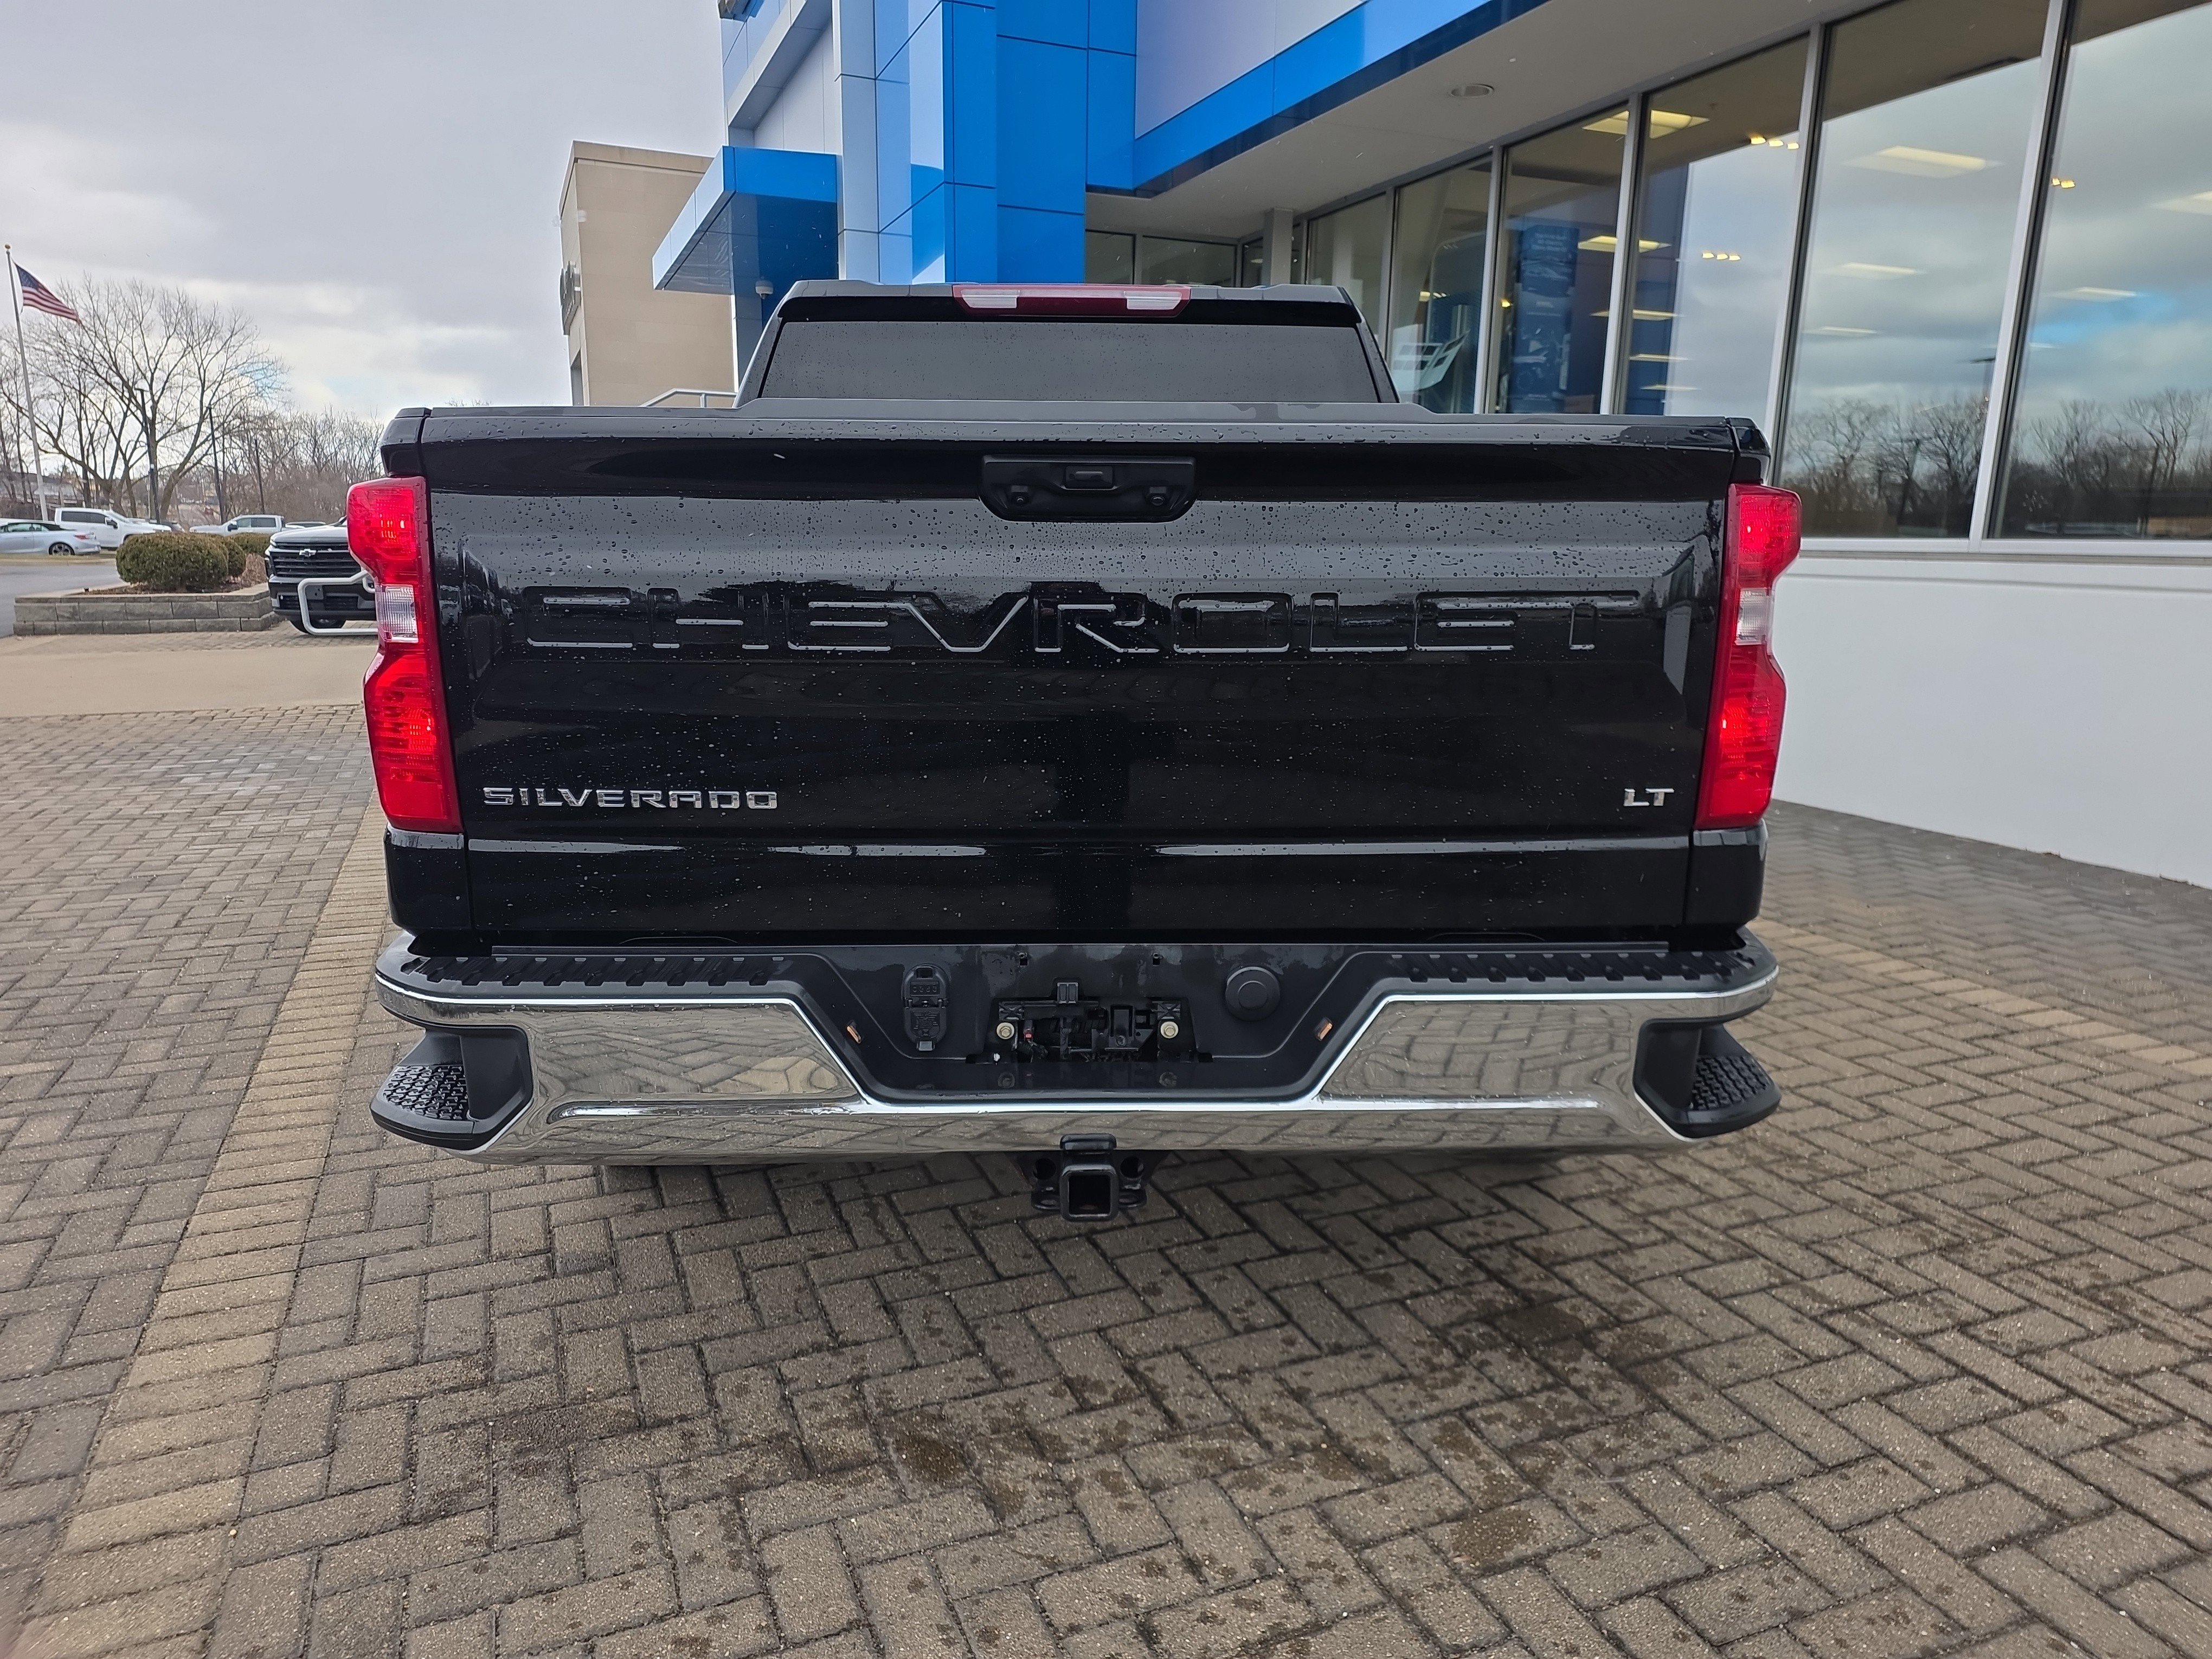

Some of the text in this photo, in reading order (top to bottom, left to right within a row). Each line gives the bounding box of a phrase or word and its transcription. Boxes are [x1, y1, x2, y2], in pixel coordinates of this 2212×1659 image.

[523, 583, 1640, 653] CHEVROLET
[483, 787, 779, 809] SILVERADO
[1623, 788, 1675, 807] LT
